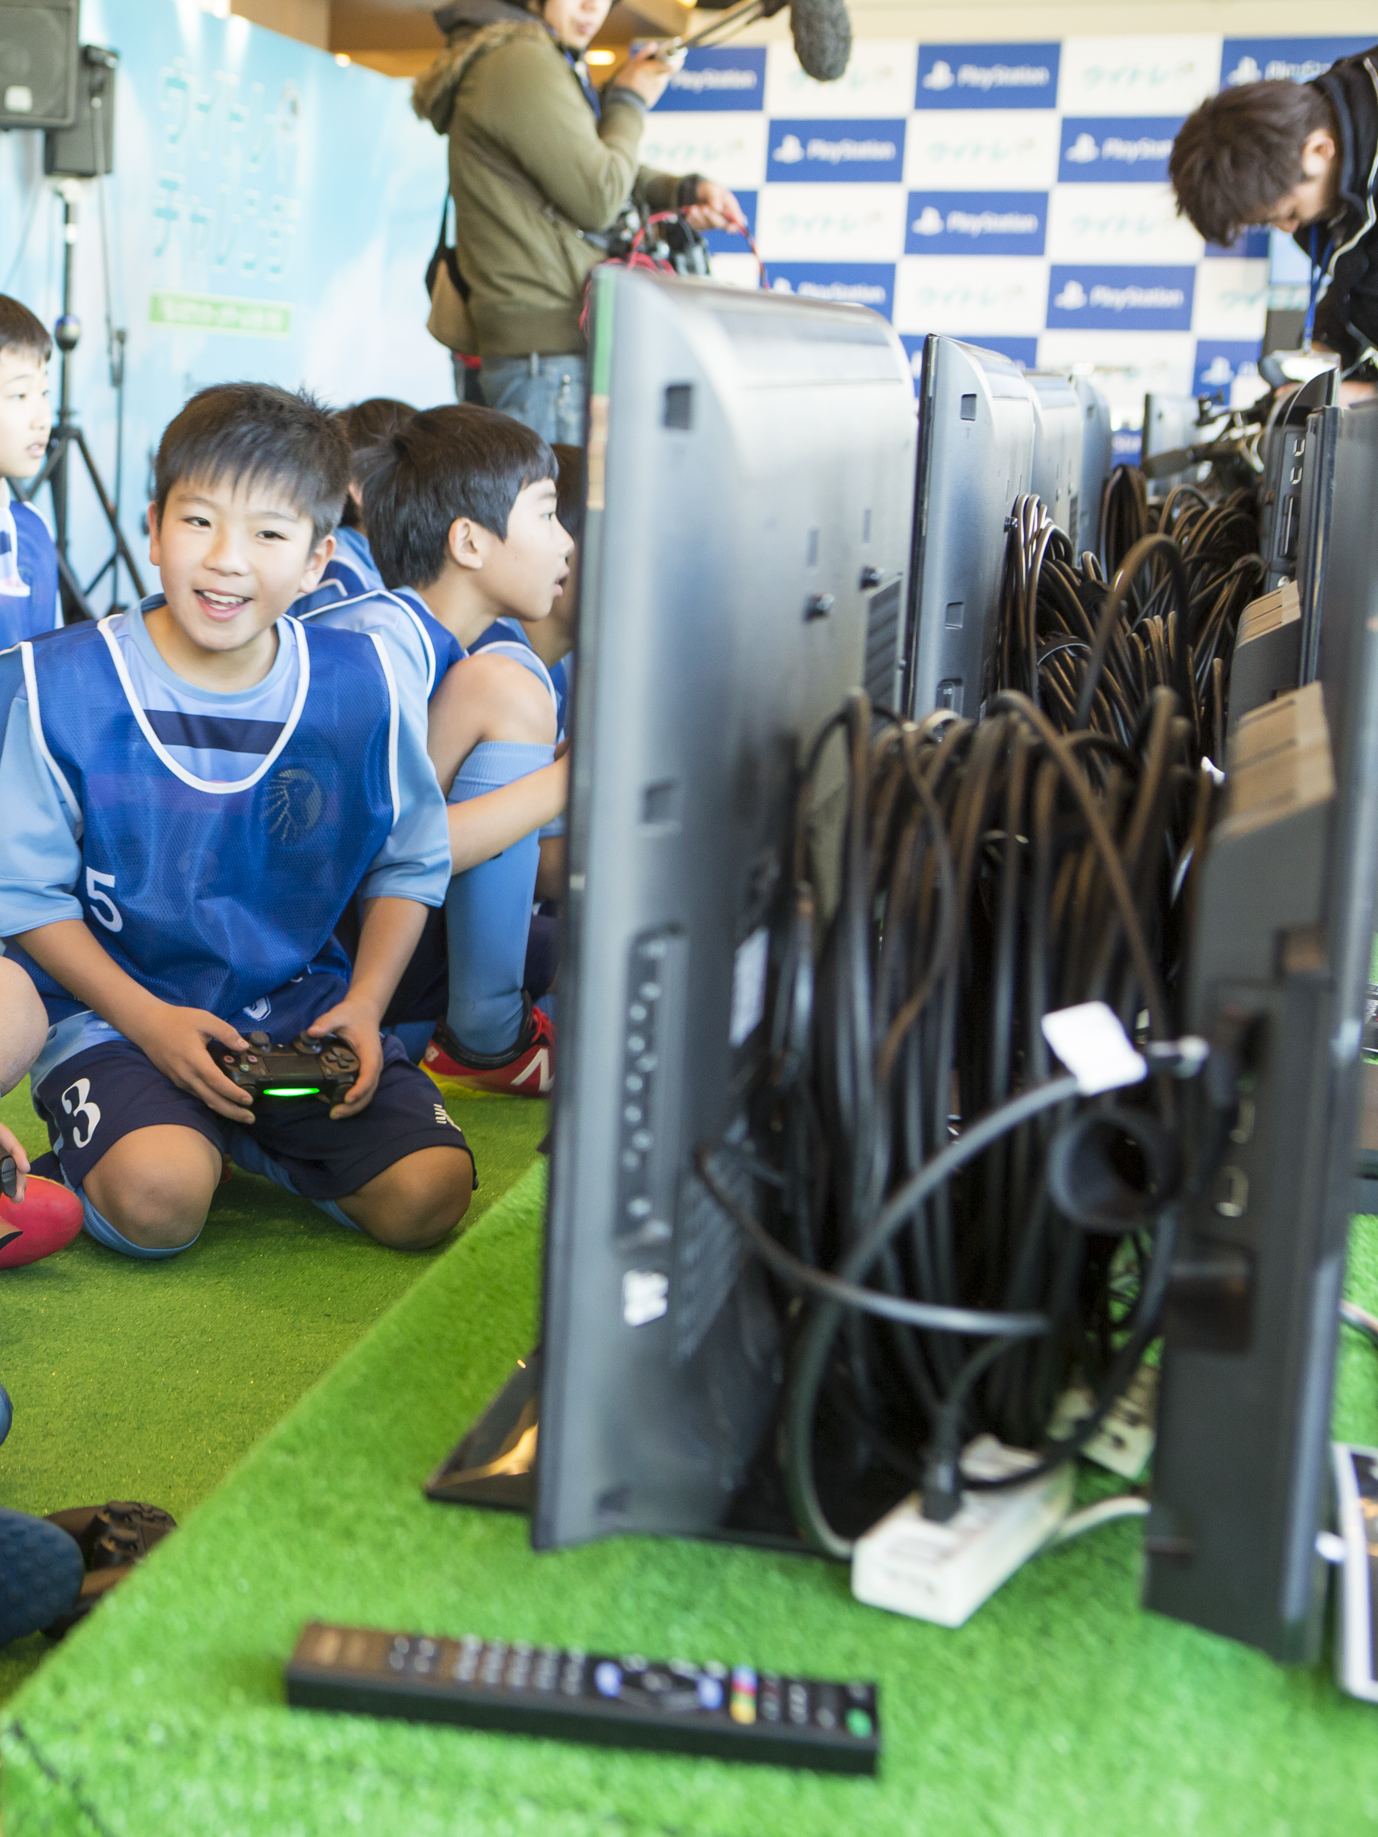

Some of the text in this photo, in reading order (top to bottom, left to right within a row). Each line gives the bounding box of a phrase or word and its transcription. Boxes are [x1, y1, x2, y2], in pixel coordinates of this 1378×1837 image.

[957, 63, 1050, 92] PlayStation
[807, 138, 897, 165] PlayStation
[1101, 136, 1175, 165] PlayStat
[946, 210, 1040, 238] PlayStation
[1089, 284, 1185, 312] PlayStation
[86, 866, 123, 933] 5
[61, 1077, 101, 1149] 3
